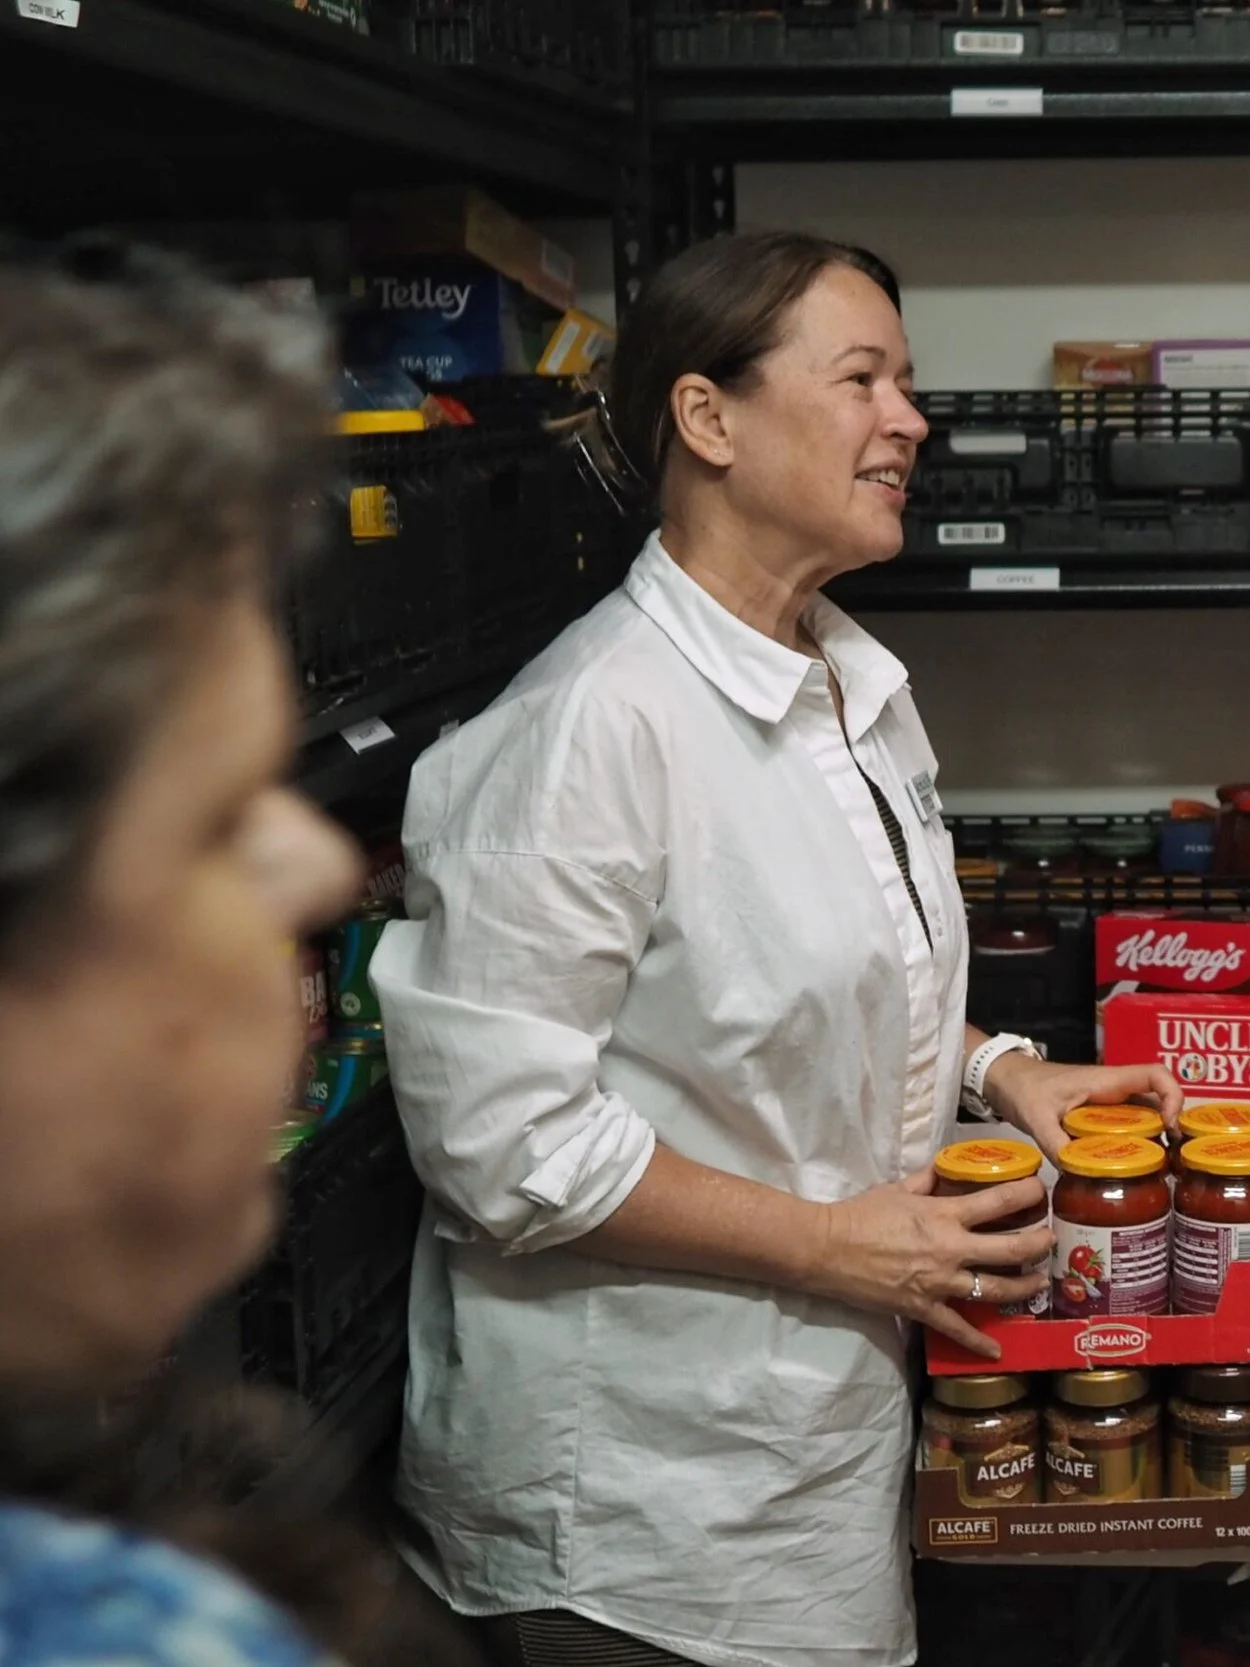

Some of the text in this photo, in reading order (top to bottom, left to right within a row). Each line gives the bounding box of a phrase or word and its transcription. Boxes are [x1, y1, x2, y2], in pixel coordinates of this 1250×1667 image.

[374, 276, 472, 320] Tetley
[400, 356, 453, 370] TEA CUP
[1115, 929, 1246, 982] Kellogg's
[1080, 1333, 1142, 1349] REMANO
[977, 1452, 1036, 1482] ALCAFE
[937, 1521, 990, 1535] ALCAFE
[1010, 1517, 1203, 1536] FREEZE DRIED INSTANT COFFEE
[1215, 1527, 1225, 1538] 12
[1228, 1529, 1234, 1537] x
